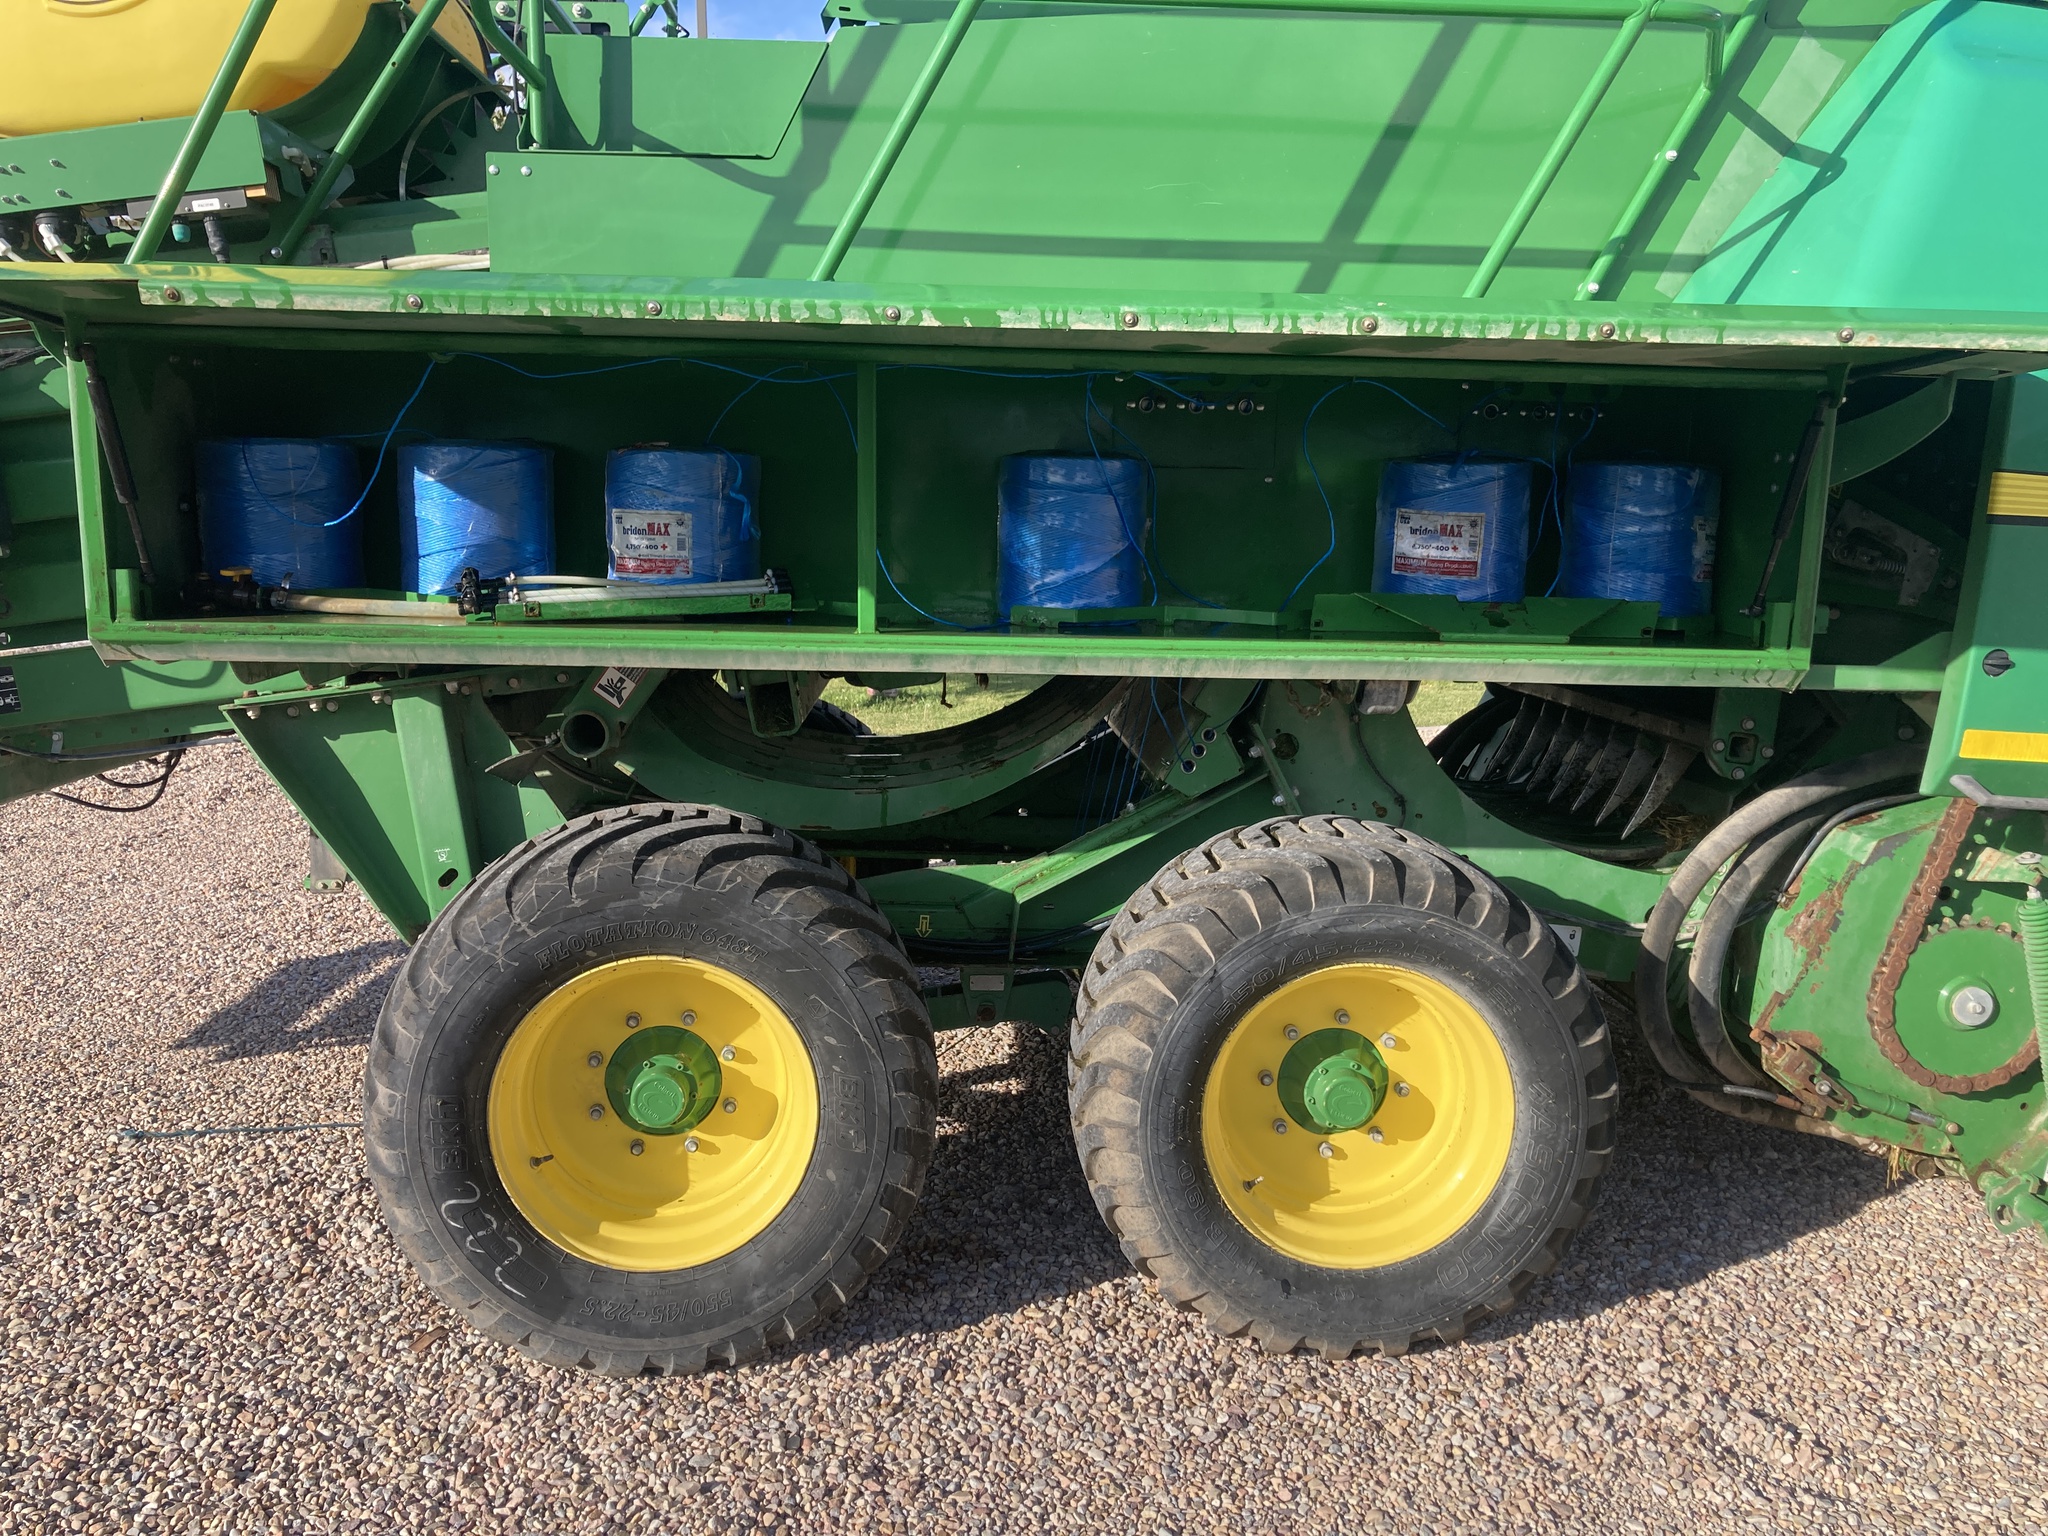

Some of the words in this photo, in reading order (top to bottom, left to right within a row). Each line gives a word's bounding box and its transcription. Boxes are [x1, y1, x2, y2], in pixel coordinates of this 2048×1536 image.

[622, 522, 670, 536] bridonMAX
[1395, 556, 1427, 567] MAXIMUM
[534, 919, 698, 971] FLOTATION
